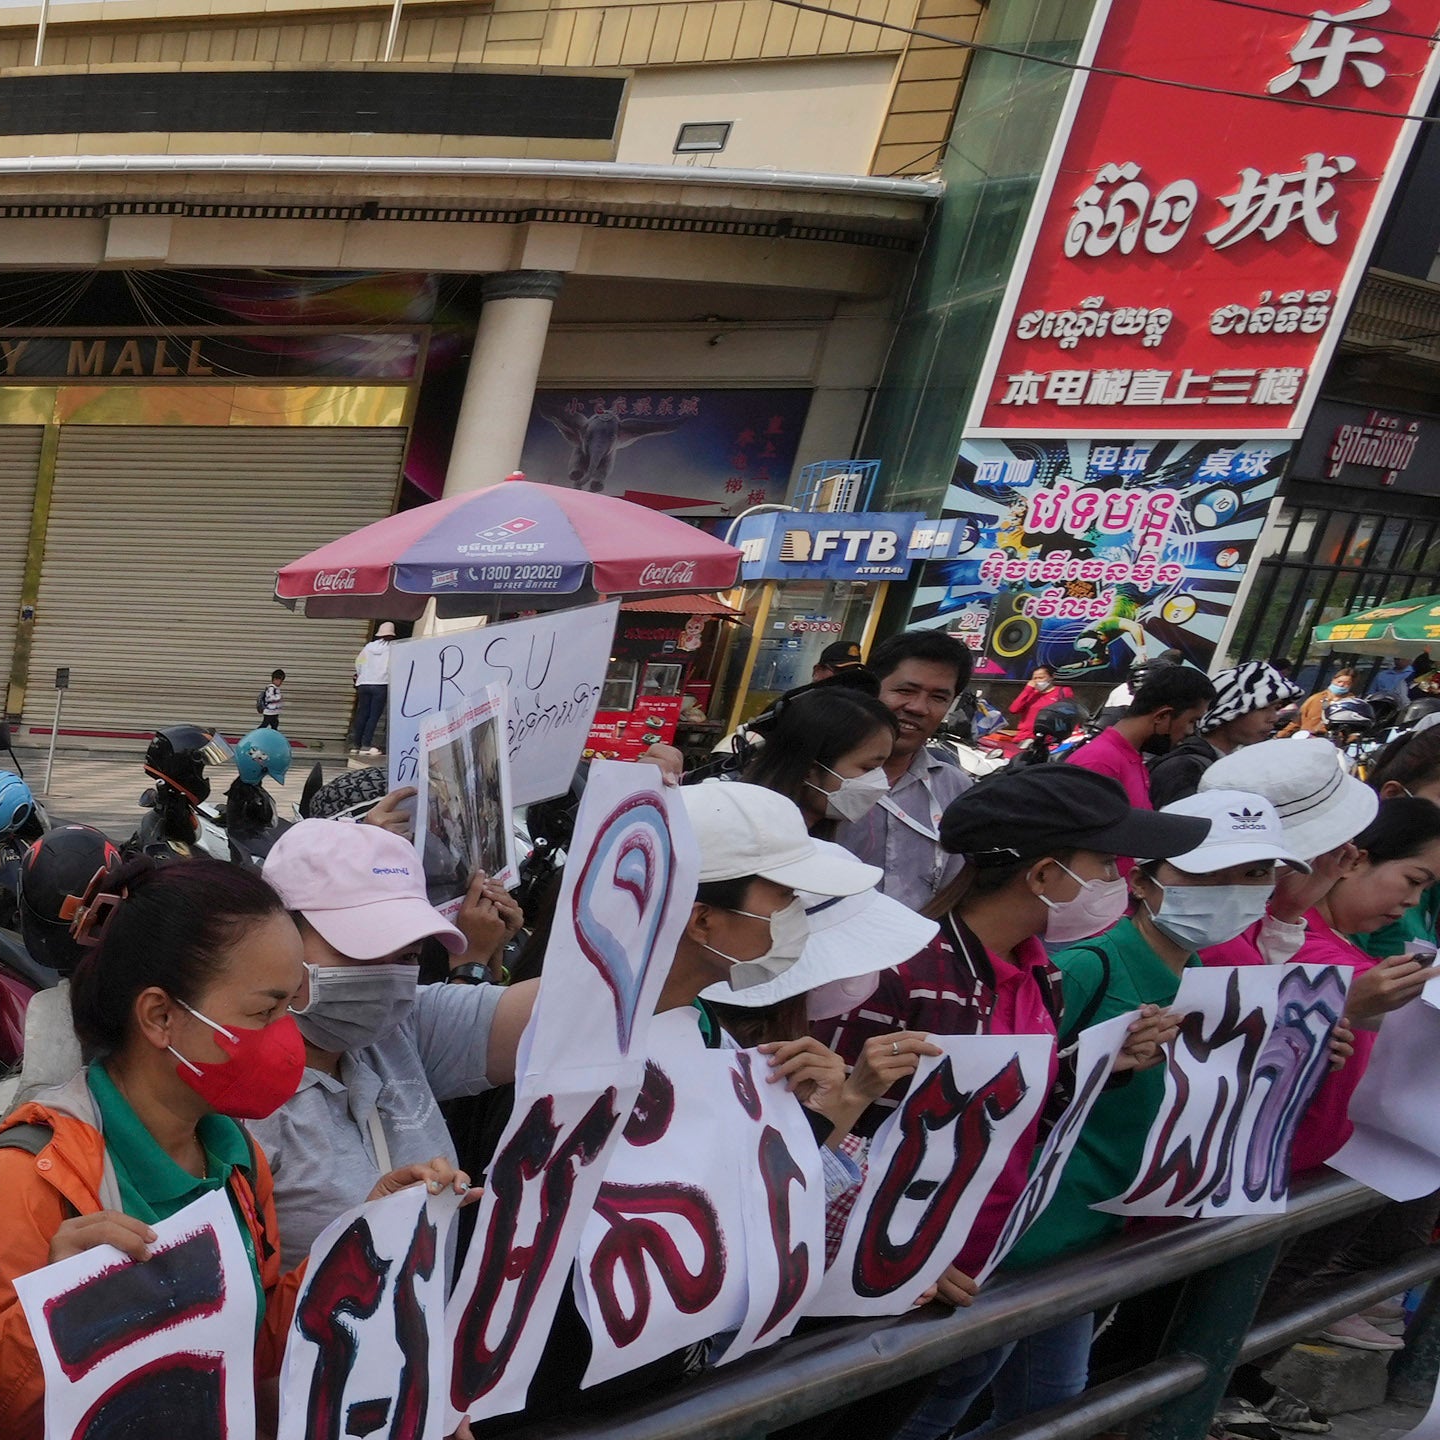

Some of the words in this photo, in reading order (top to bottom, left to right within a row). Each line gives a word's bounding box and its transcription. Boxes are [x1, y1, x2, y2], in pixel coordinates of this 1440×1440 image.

[66, 340, 216, 377] MALL
[1003, 367, 1306, 407] 本电梯直上三楼
[1091, 446, 1152, 472] 电玩
[1199, 448, 1272, 478] 桌球
[811, 530, 898, 562] FTB
[514, 564, 563, 580] 202020
[1231, 823, 1267, 831] adidas
